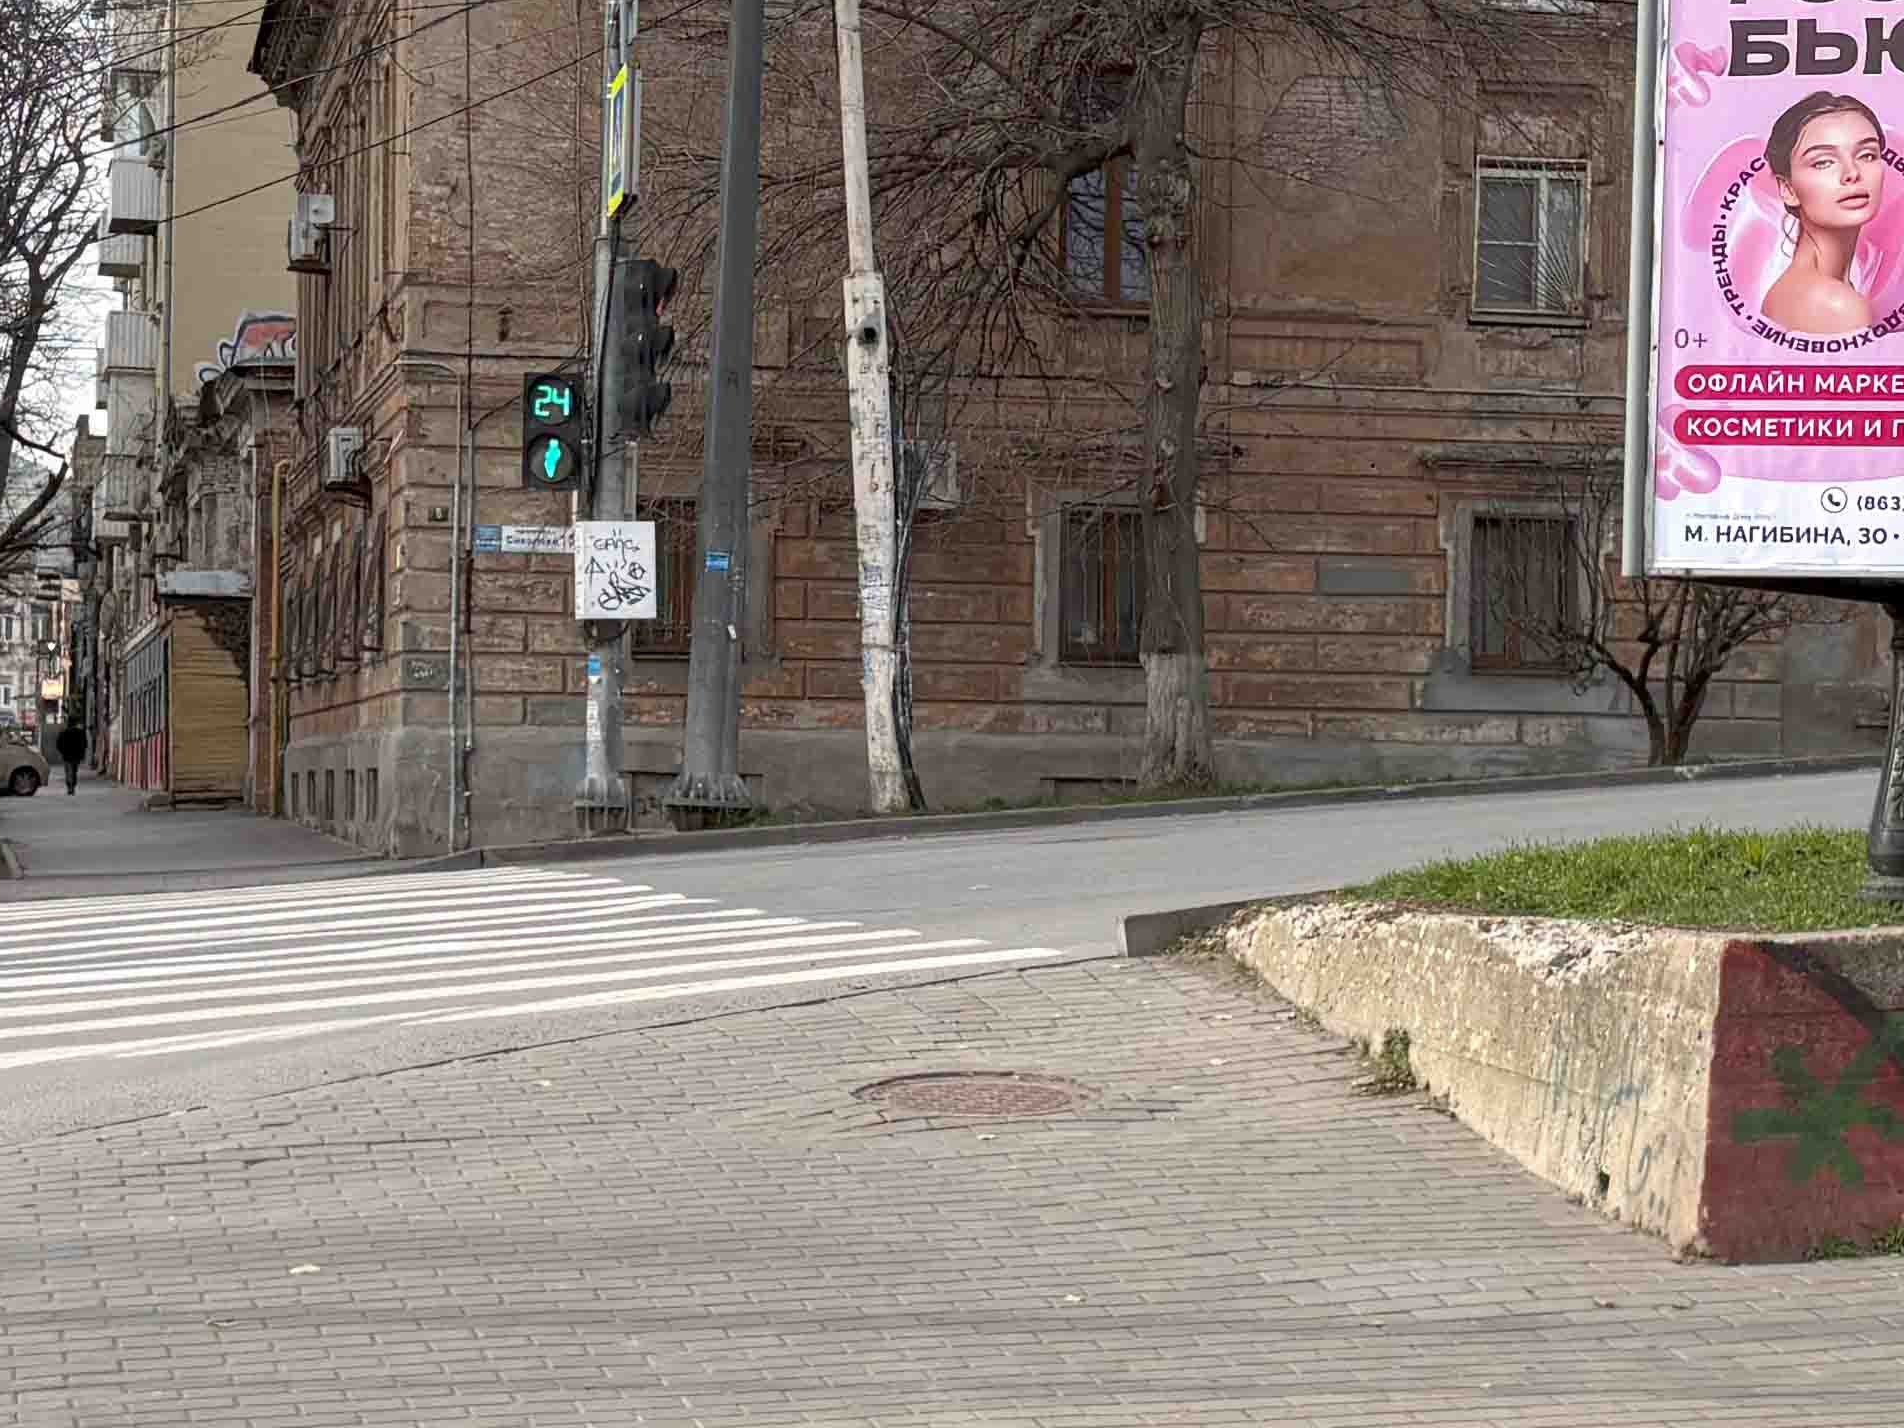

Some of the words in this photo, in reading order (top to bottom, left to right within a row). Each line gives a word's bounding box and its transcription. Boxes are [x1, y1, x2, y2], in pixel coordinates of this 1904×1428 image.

[1711, 224, 1745, 316] ТРЕНДЫ
[1674, 328, 1707, 349] 0+
[1687, 369, 1805, 395] ОФЛАЙН
[535, 385, 570, 416] 24
[1686, 417, 1853, 439] КОСМЕТИКИ
[1864, 418, 1882, 439] И
[1684, 525, 1709, 543] М.
[1716, 525, 1851, 547] НАГИБИНА,
[1858, 527, 1888, 546] 30
